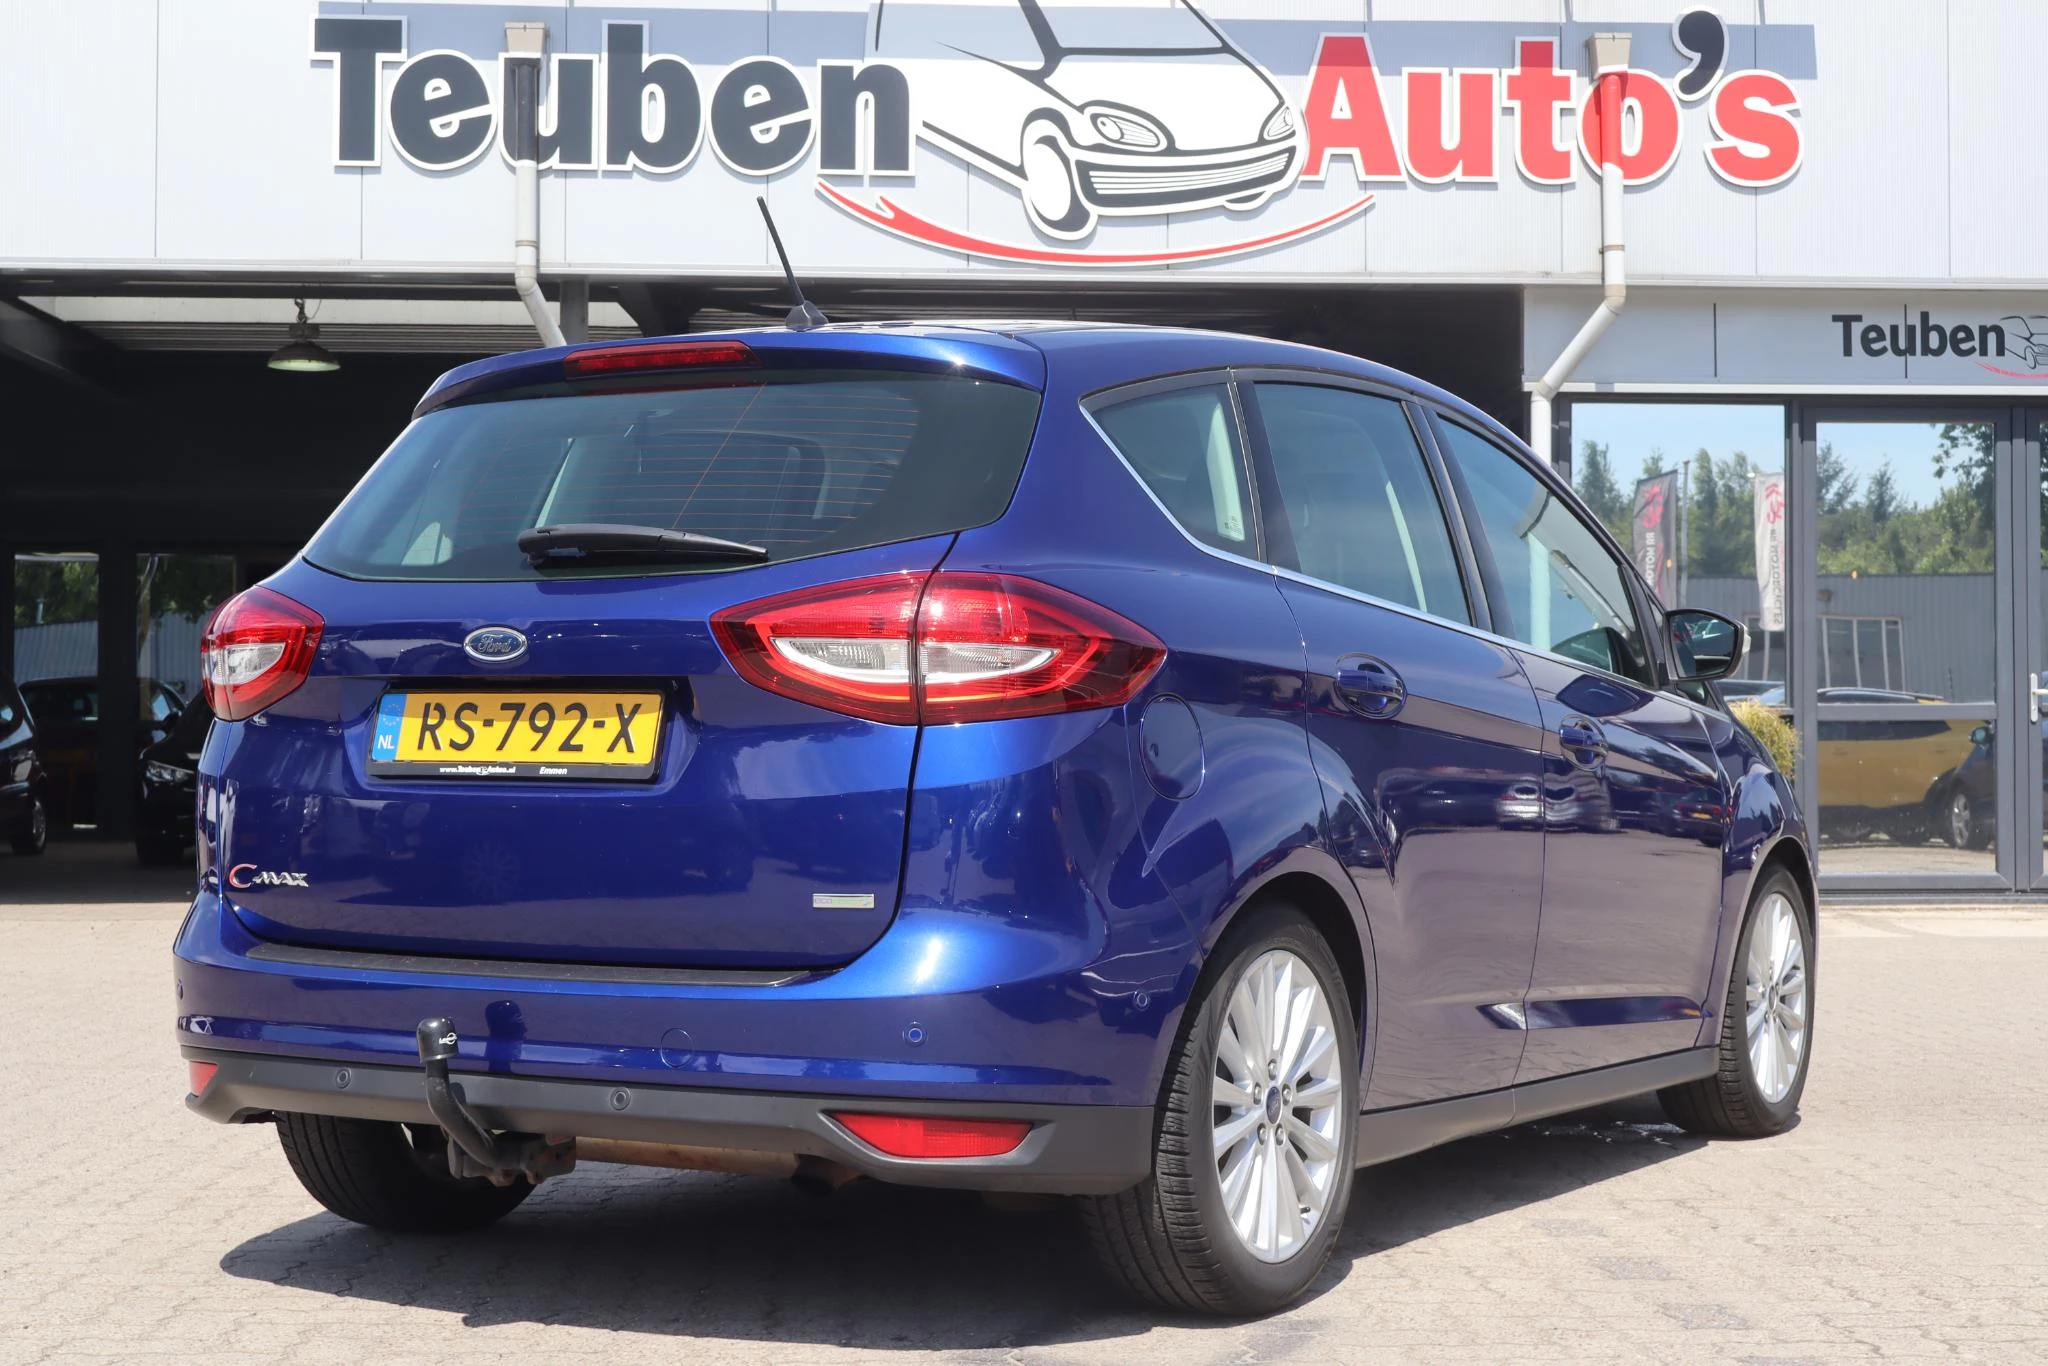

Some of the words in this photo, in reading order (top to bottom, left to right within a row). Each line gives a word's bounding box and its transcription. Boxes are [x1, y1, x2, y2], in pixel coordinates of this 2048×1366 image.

[311, 15, 915, 176] Teuben
[1299, 6, 1804, 186] Auto's
[1832, 311, 2006, 357] Teuben
[478, 633, 512, 653] Ford
[378, 734, 395, 749] NL
[417, 702, 642, 753] RS-792-X
[539, 766, 568, 775] Emmen
